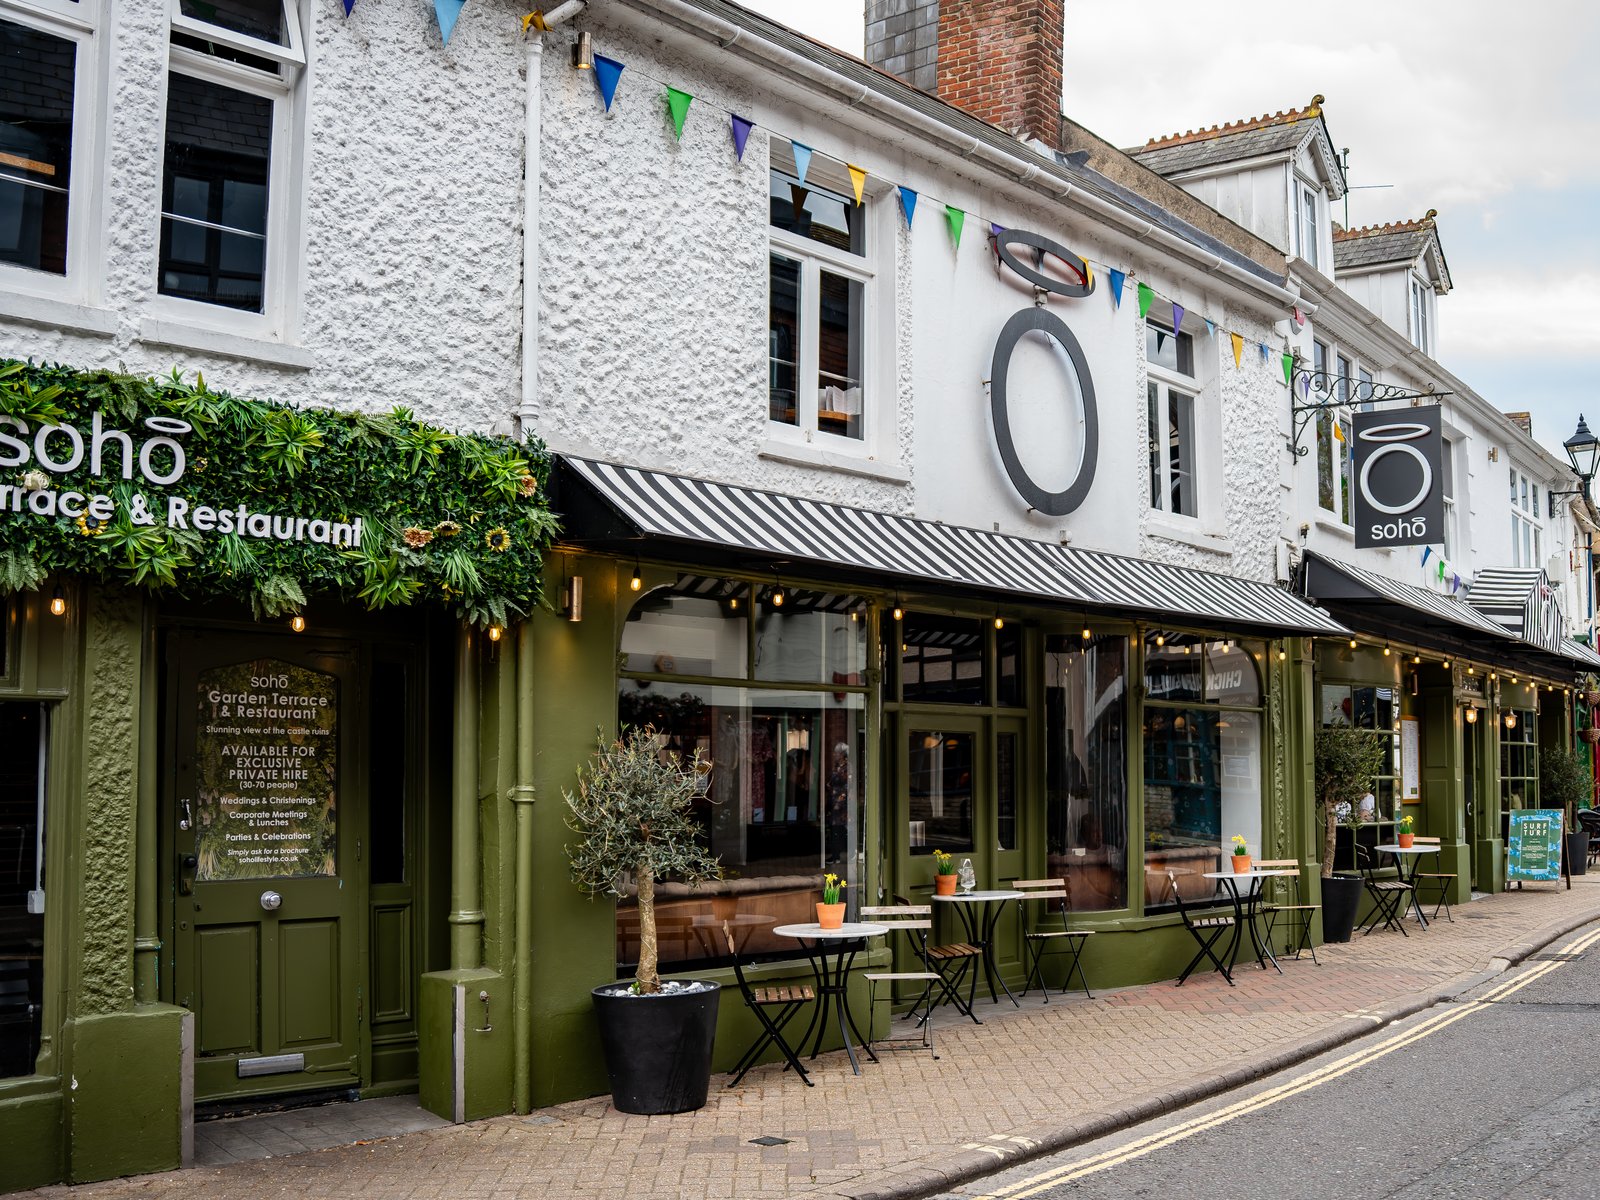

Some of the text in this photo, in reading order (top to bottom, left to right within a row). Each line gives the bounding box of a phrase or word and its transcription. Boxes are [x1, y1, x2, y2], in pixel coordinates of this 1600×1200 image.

[130, 493, 156, 526] &
[168, 496, 362, 547] Restaurant
[208, 690, 328, 707] Garden Terrace
[221, 705, 317, 719] & Restaurant
[206, 725, 330, 736] Stunning view of the castle ruins
[221, 745, 316, 757] AVAILABLE FOR
[236, 757, 302, 768] EXCLUSIVE
[229, 769, 309, 780] PRIVATE HIRE
[239, 780, 298, 790] (30-70 people)
[220, 796, 317, 806] Weddings & Christenings
[229, 810, 308, 820] Corporate Meetings
[248, 818, 289, 827] & Lunches
[225, 832, 312, 842] Parties & Celebrations
[227, 848, 250, 857] Simply
[250, 847, 263, 855] ask
[263, 847, 273, 855] for
[279, 847, 309, 855] brochure
[238, 854, 299, 864] soholifestyle.co.uk
